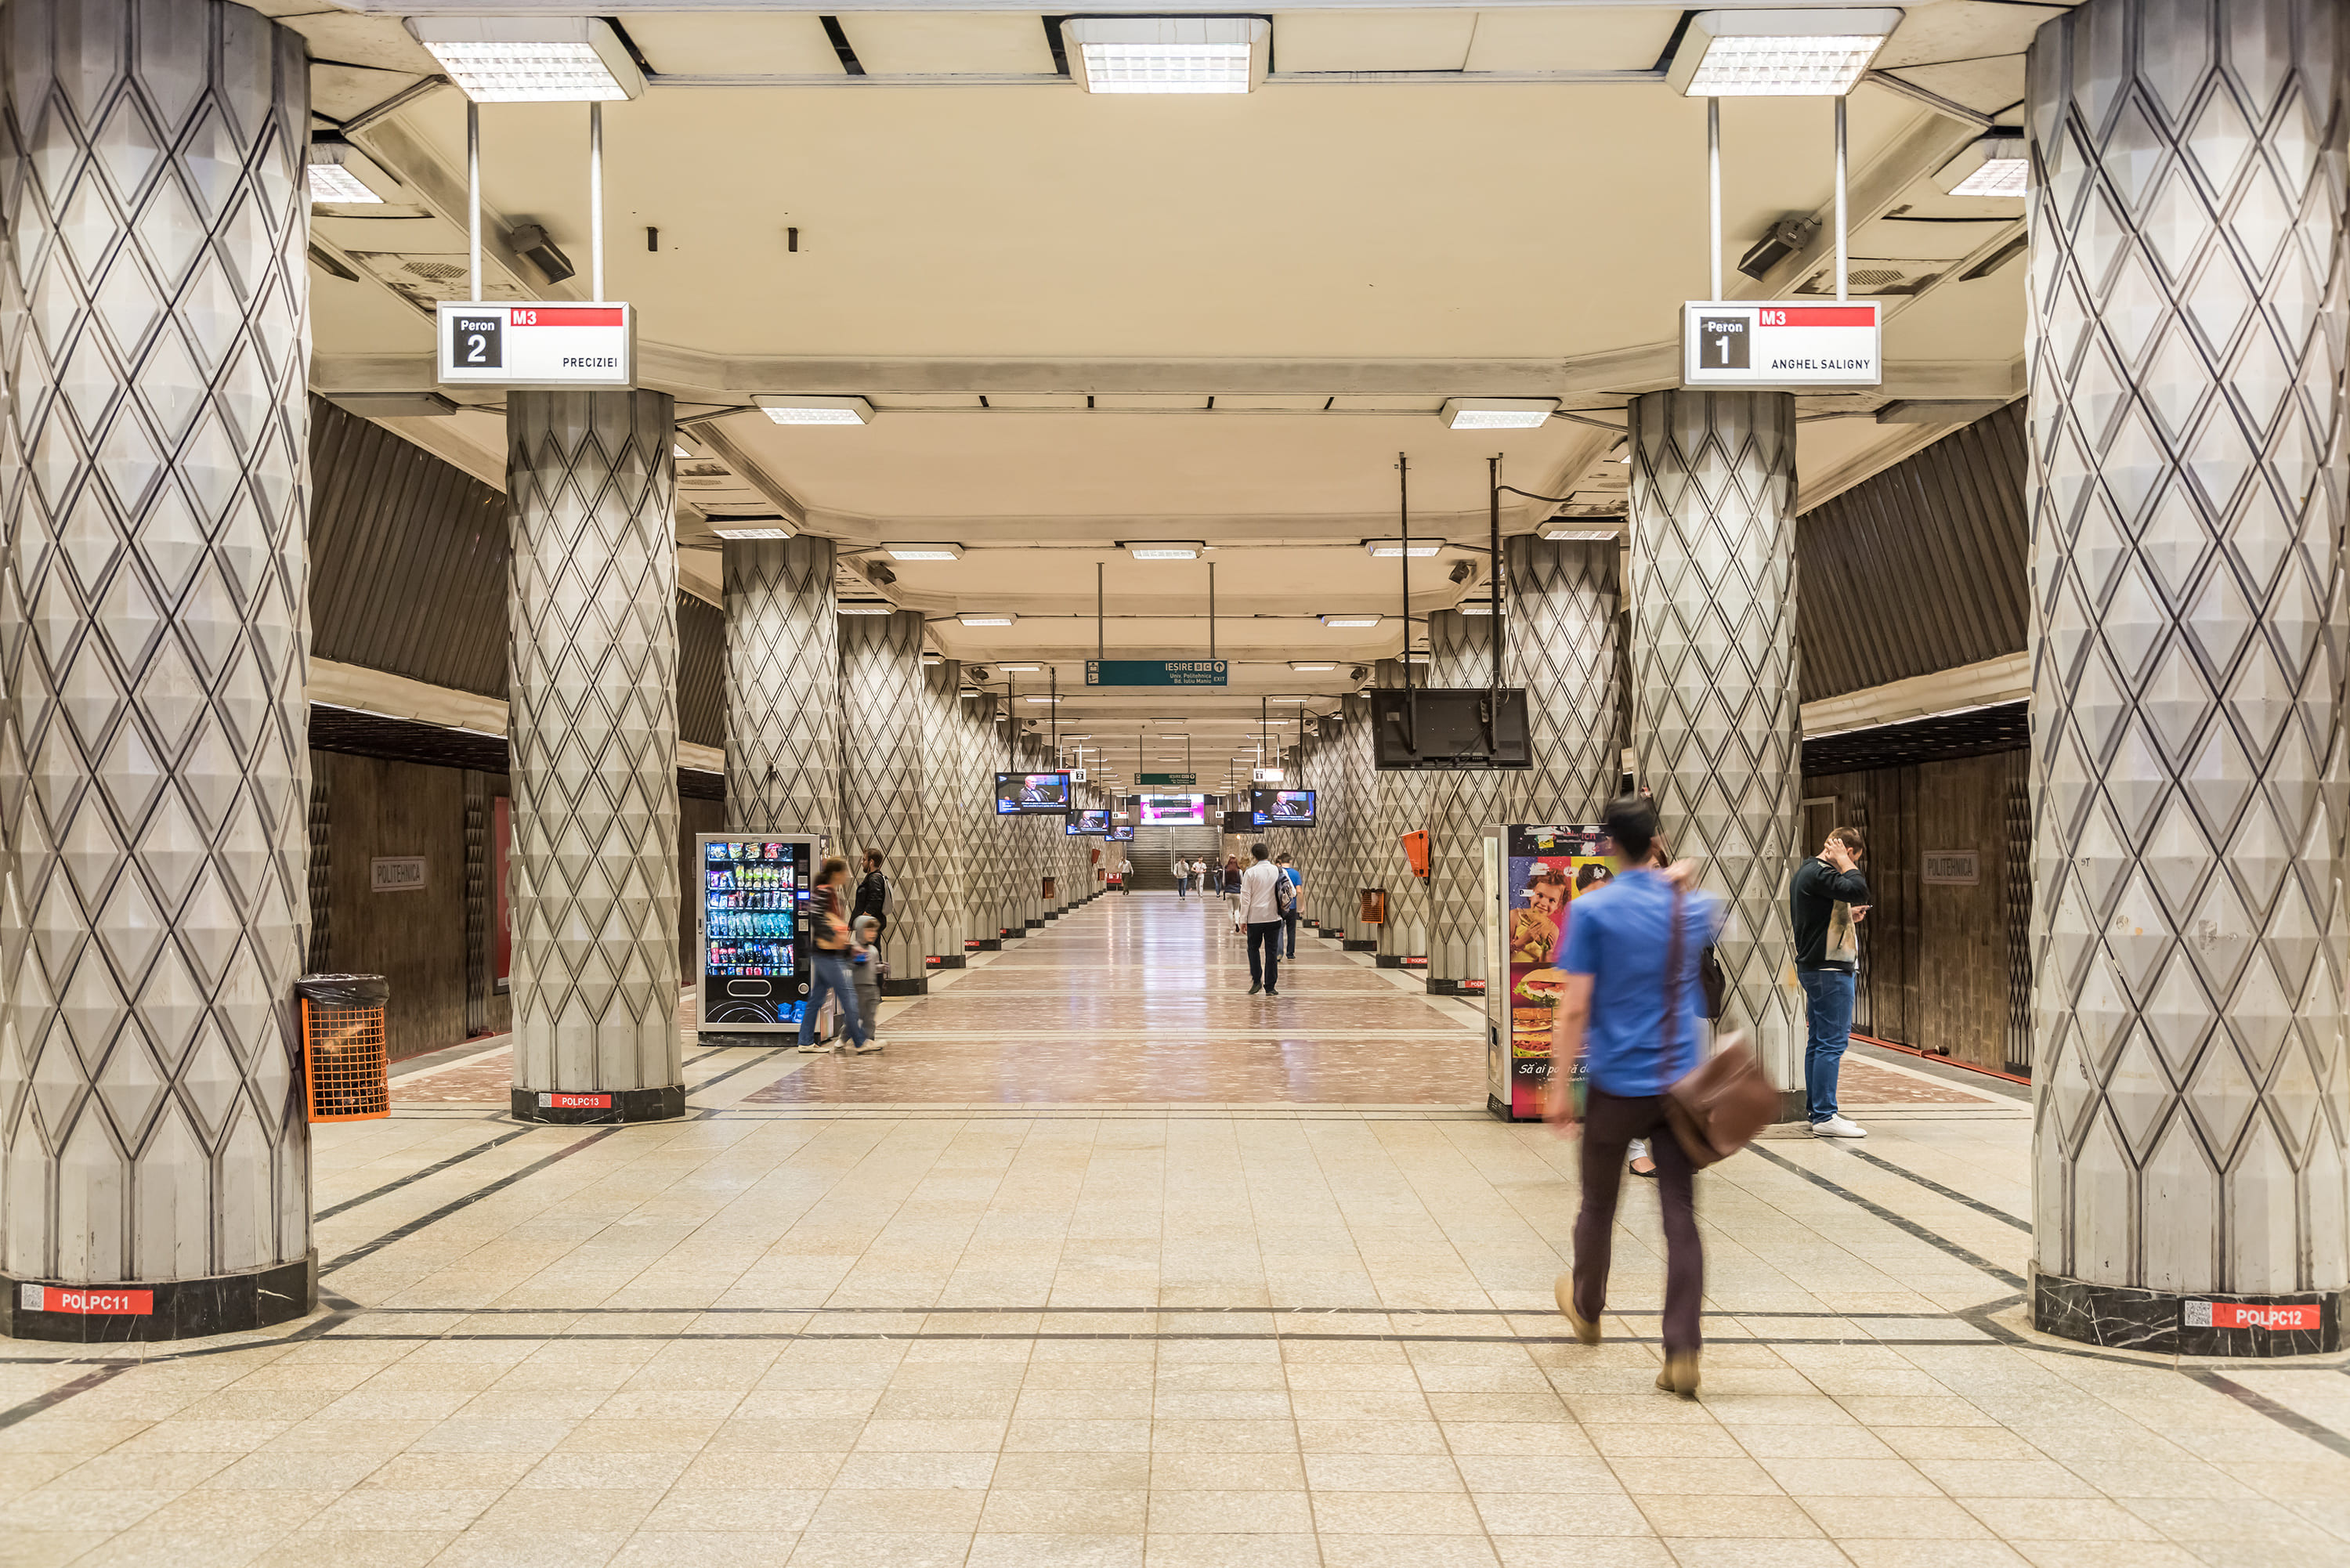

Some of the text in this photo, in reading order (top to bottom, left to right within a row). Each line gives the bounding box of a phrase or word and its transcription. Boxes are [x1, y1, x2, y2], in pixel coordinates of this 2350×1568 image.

[513, 310, 537, 325] M3
[1761, 310, 1787, 326] M3
[461, 320, 495, 331] Peron
[1708, 320, 1744, 333] Peron
[468, 334, 486, 363] 2
[1716, 335, 1730, 364] 1
[562, 357, 617, 367] PRECIZIEI
[1771, 359, 1871, 370] ANGHEL SALIGNY
[1927, 858, 1973, 876] POLITEHNICA
[2081, 858, 2091, 867] ST
[377, 864, 421, 884] POLITEHNICA
[1519, 1064, 1535, 1074] Să
[1535, 1064, 1545, 1074] ai
[1547, 1064, 1578, 1076] potă
[562, 1097, 599, 1106] POLPC13
[62, 1293, 128, 1310] POLPC11
[2236, 1309, 2302, 1325] POLPC12
